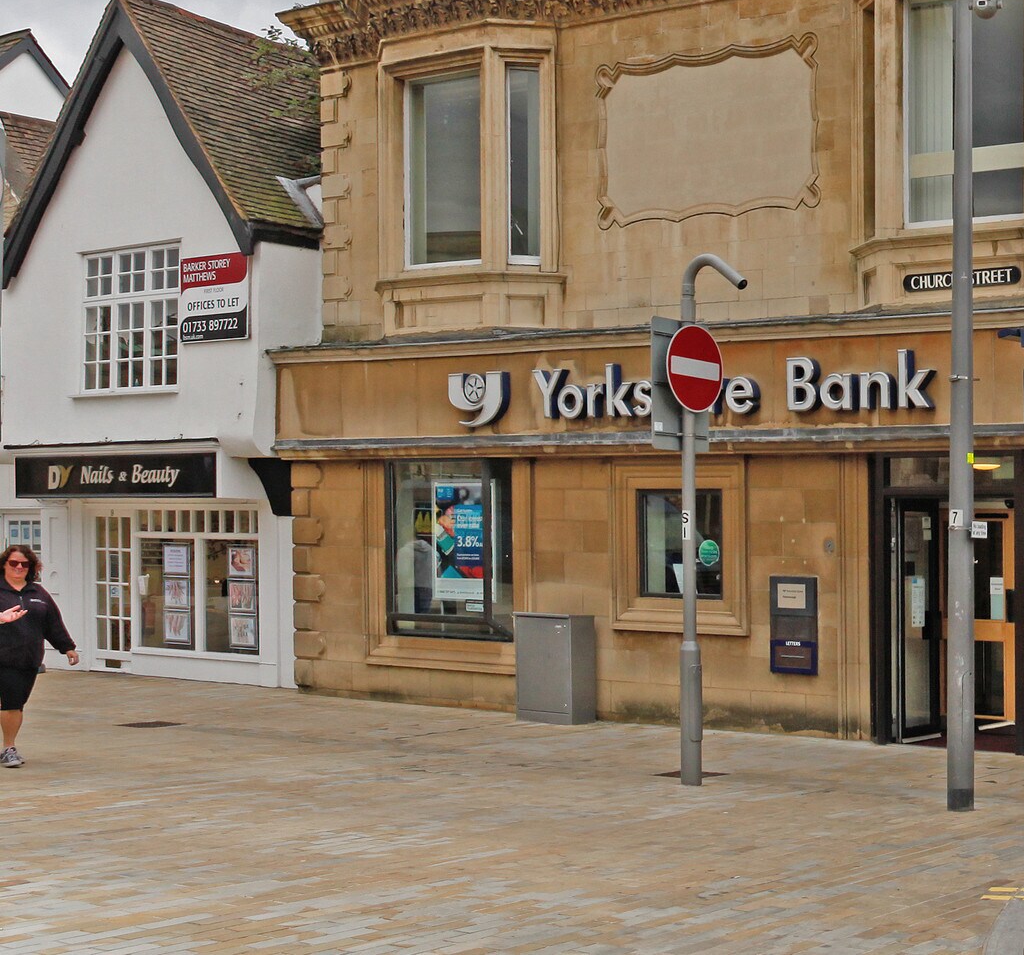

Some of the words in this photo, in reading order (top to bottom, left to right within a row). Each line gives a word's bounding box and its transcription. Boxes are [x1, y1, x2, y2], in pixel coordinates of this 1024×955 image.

[183, 261, 206, 272] BARKER
[207, 258, 231, 269] STOREY
[183, 271, 216, 283] MATTHEWS
[911, 273, 953, 290] CHURC
[187, 299, 215, 311] OFFICES
[217, 298, 226, 308] TO
[227, 297, 239, 307] LET
[182, 320, 207, 334] 01733
[208, 317, 238, 332] 897722
[532, 363, 761, 419] Yorkse
[786, 349, 936, 412] Bank
[80, 465, 113, 485] Nails
[118, 471, 127, 482] &
[131, 464, 180, 487] Beauty
[952, 511, 958, 524] 7
[456, 535, 479, 548] 3.8%
